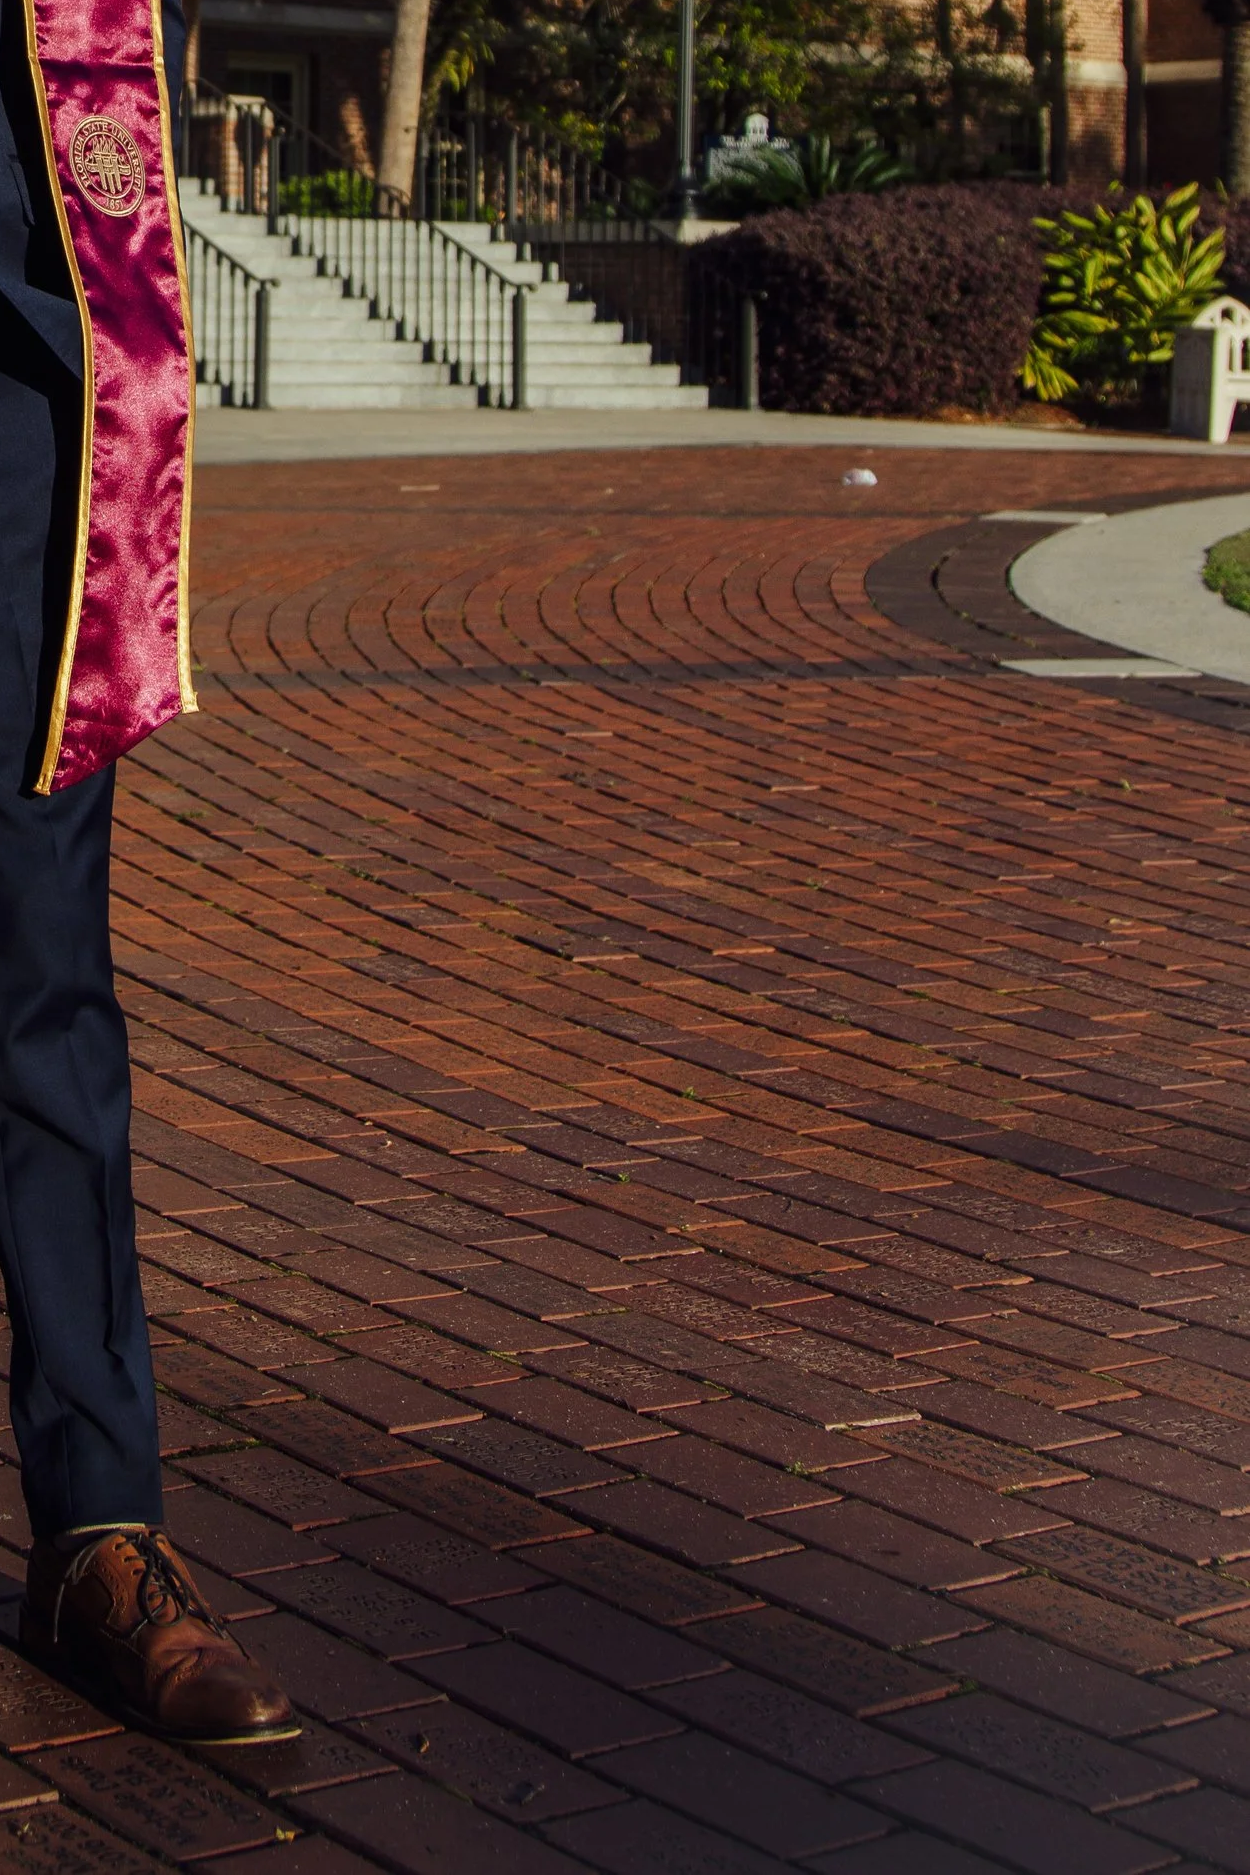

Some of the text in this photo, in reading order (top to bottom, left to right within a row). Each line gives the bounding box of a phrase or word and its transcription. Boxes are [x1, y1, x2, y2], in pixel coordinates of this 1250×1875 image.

[73, 122, 143, 195] FLORIDA STATE UNIVERSITY
